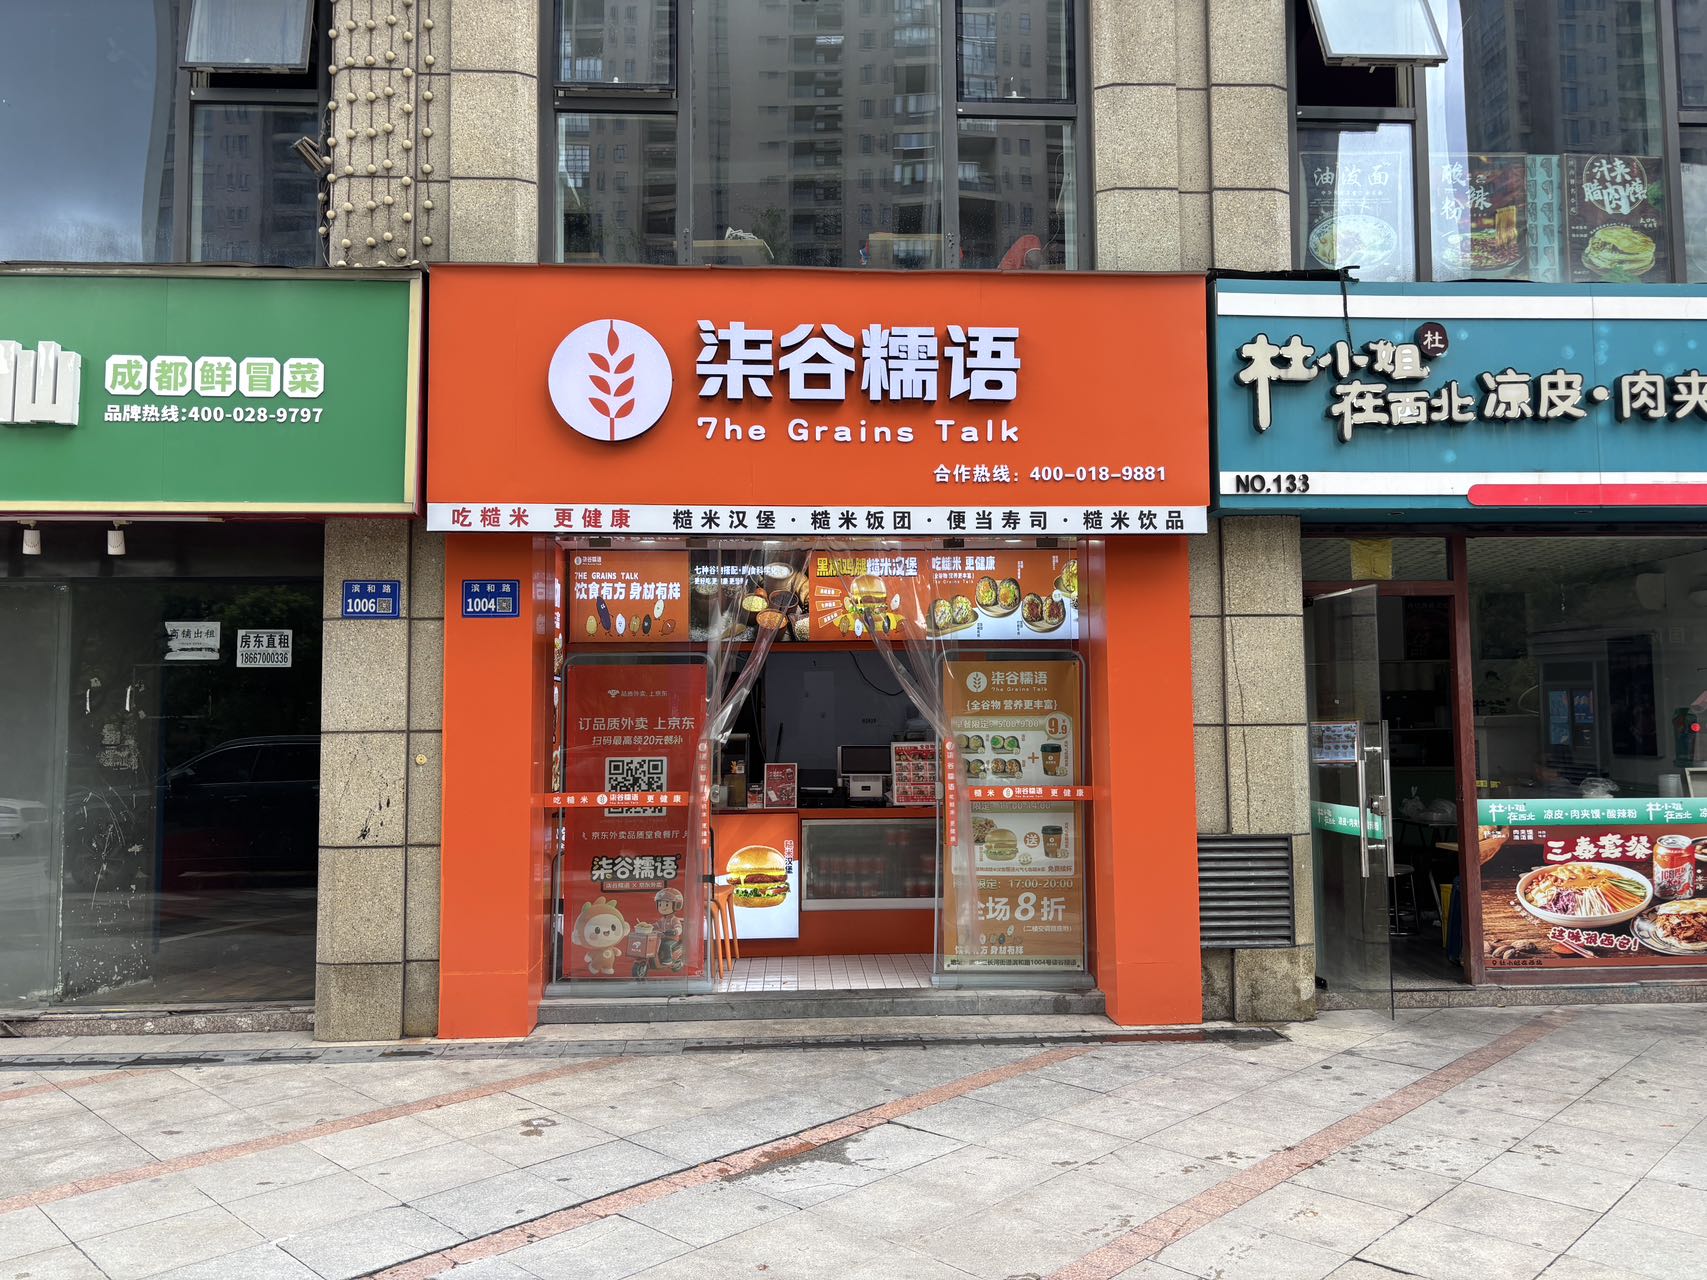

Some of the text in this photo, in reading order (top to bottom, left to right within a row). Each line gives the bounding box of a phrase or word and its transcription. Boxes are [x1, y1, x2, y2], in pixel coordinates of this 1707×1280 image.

[1422, 329, 1446, 351] 杜
[696, 319, 1021, 402] 柒谷糯语
[107, 356, 323, 398] 成都鲜冒菜
[1236, 333, 1430, 432] 杜小姐
[104, 404, 324, 424] 品牌热线:400-028-9797
[1328, 379, 1477, 443] 在西北
[788, 417, 915, 442] Grains
[934, 418, 1020, 442] Talk
[1235, 473, 1310, 494] NO.133
[451, 507, 530, 529] 吃糙米
[553, 507, 632, 529] 更健康
[931, 556, 996, 571] 吃糙米 更健康
[591, 572, 617, 580] GRAINS
[621, 571, 639, 580] TALK
[351, 584, 391, 593] 滨和路
[471, 584, 511, 593] 滨和路
[574, 582, 681, 600] 饮食有方 身材有样
[346, 598, 376, 612] 1006
[466, 598, 496, 612] 1004
[240, 633, 290, 649] 房东直租
[240, 652, 289, 665] 18667000336
[991, 671, 1048, 685] 柒谷糯语
[578, 716, 696, 731] 订品质外卖 上京东
[552, 795, 589, 805] 吃糙米
[646, 794, 683, 804] 更健康
[1050, 788, 1085, 797] 更健康
[1489, 803, 1527, 822] 杜小姐
[1646, 801, 1684, 821] 杜小姐
[1026, 834, 1039, 847] 送
[1546, 832, 1654, 862] 三秦套餐
[590, 856, 679, 880] 柒谷糯语
